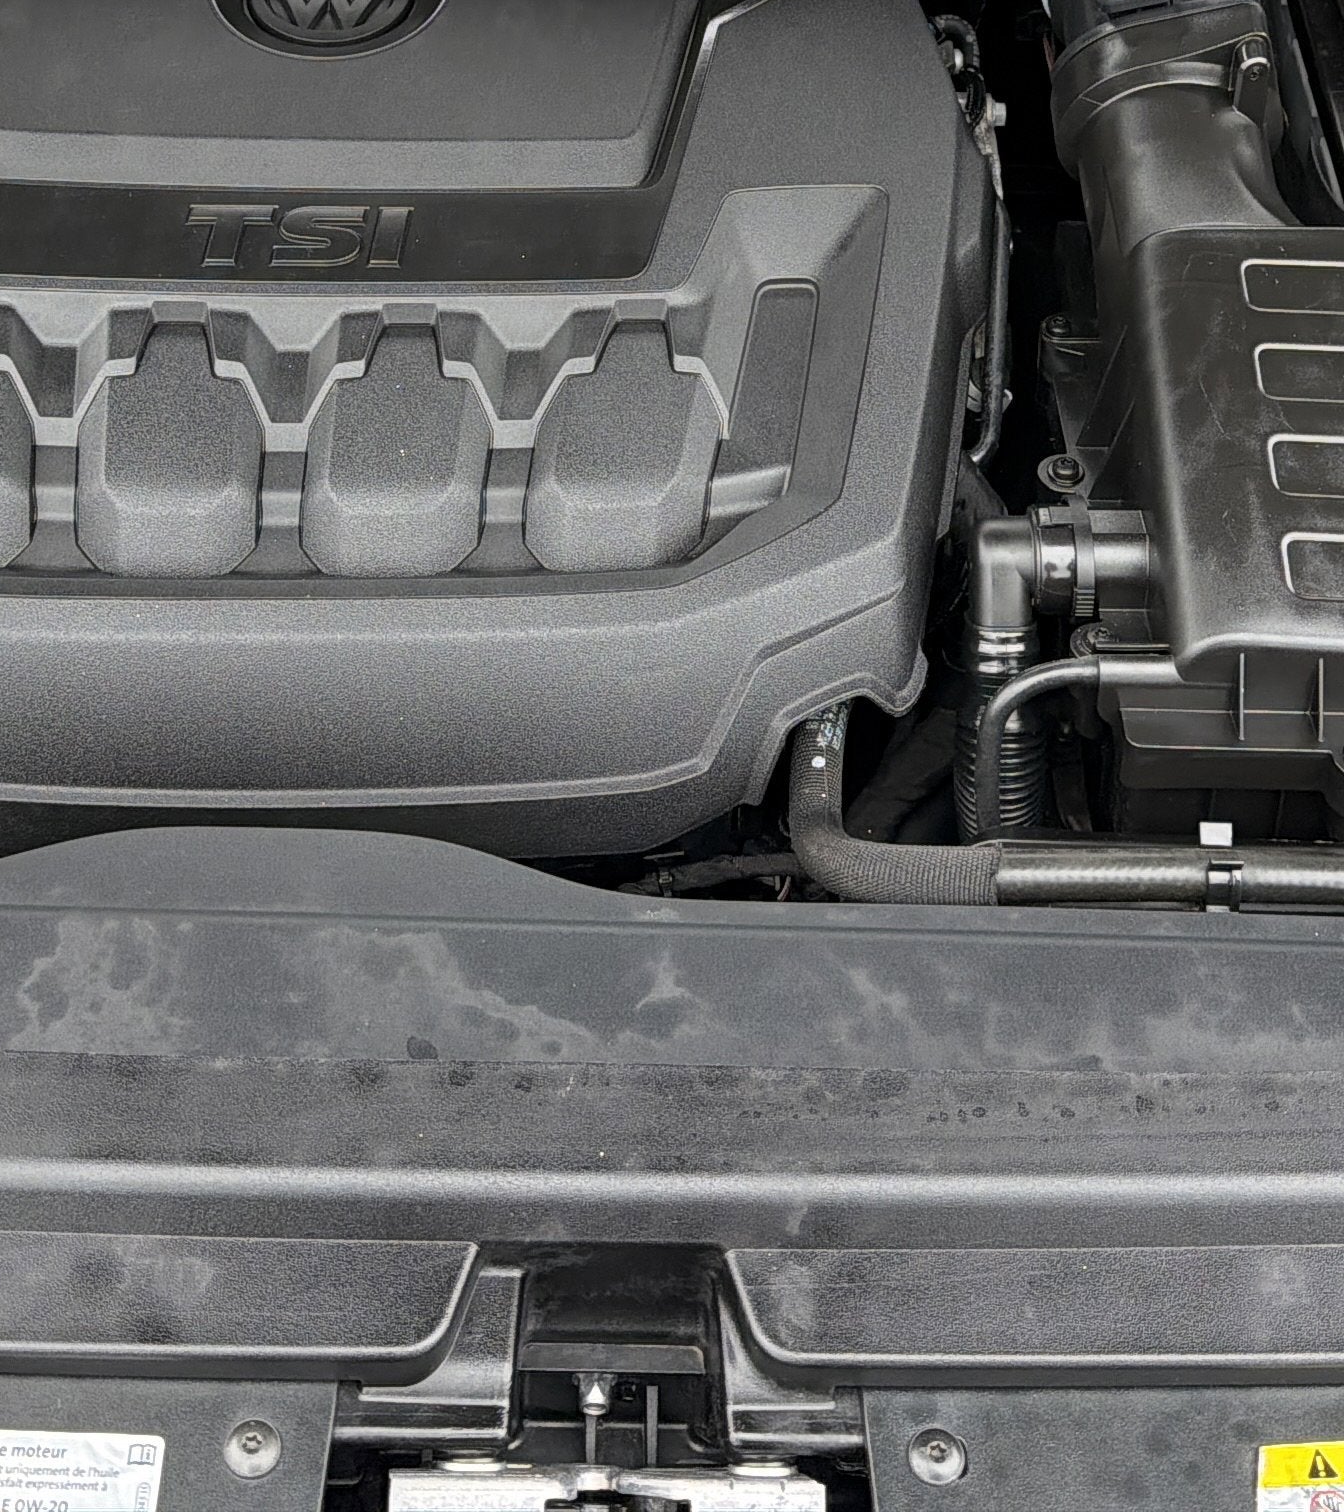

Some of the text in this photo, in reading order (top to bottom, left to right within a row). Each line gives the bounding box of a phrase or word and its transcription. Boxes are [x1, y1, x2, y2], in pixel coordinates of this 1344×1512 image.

[185, 203, 415, 269] TSI
[10, 1444, 68, 1459] moteur
[5, 1465, 70, 1478] uniquement
[72, 1467, 86, 1477] de
[25, 1478, 99, 1491] expressément
[14, 1499, 69, 1512] 0W-20
